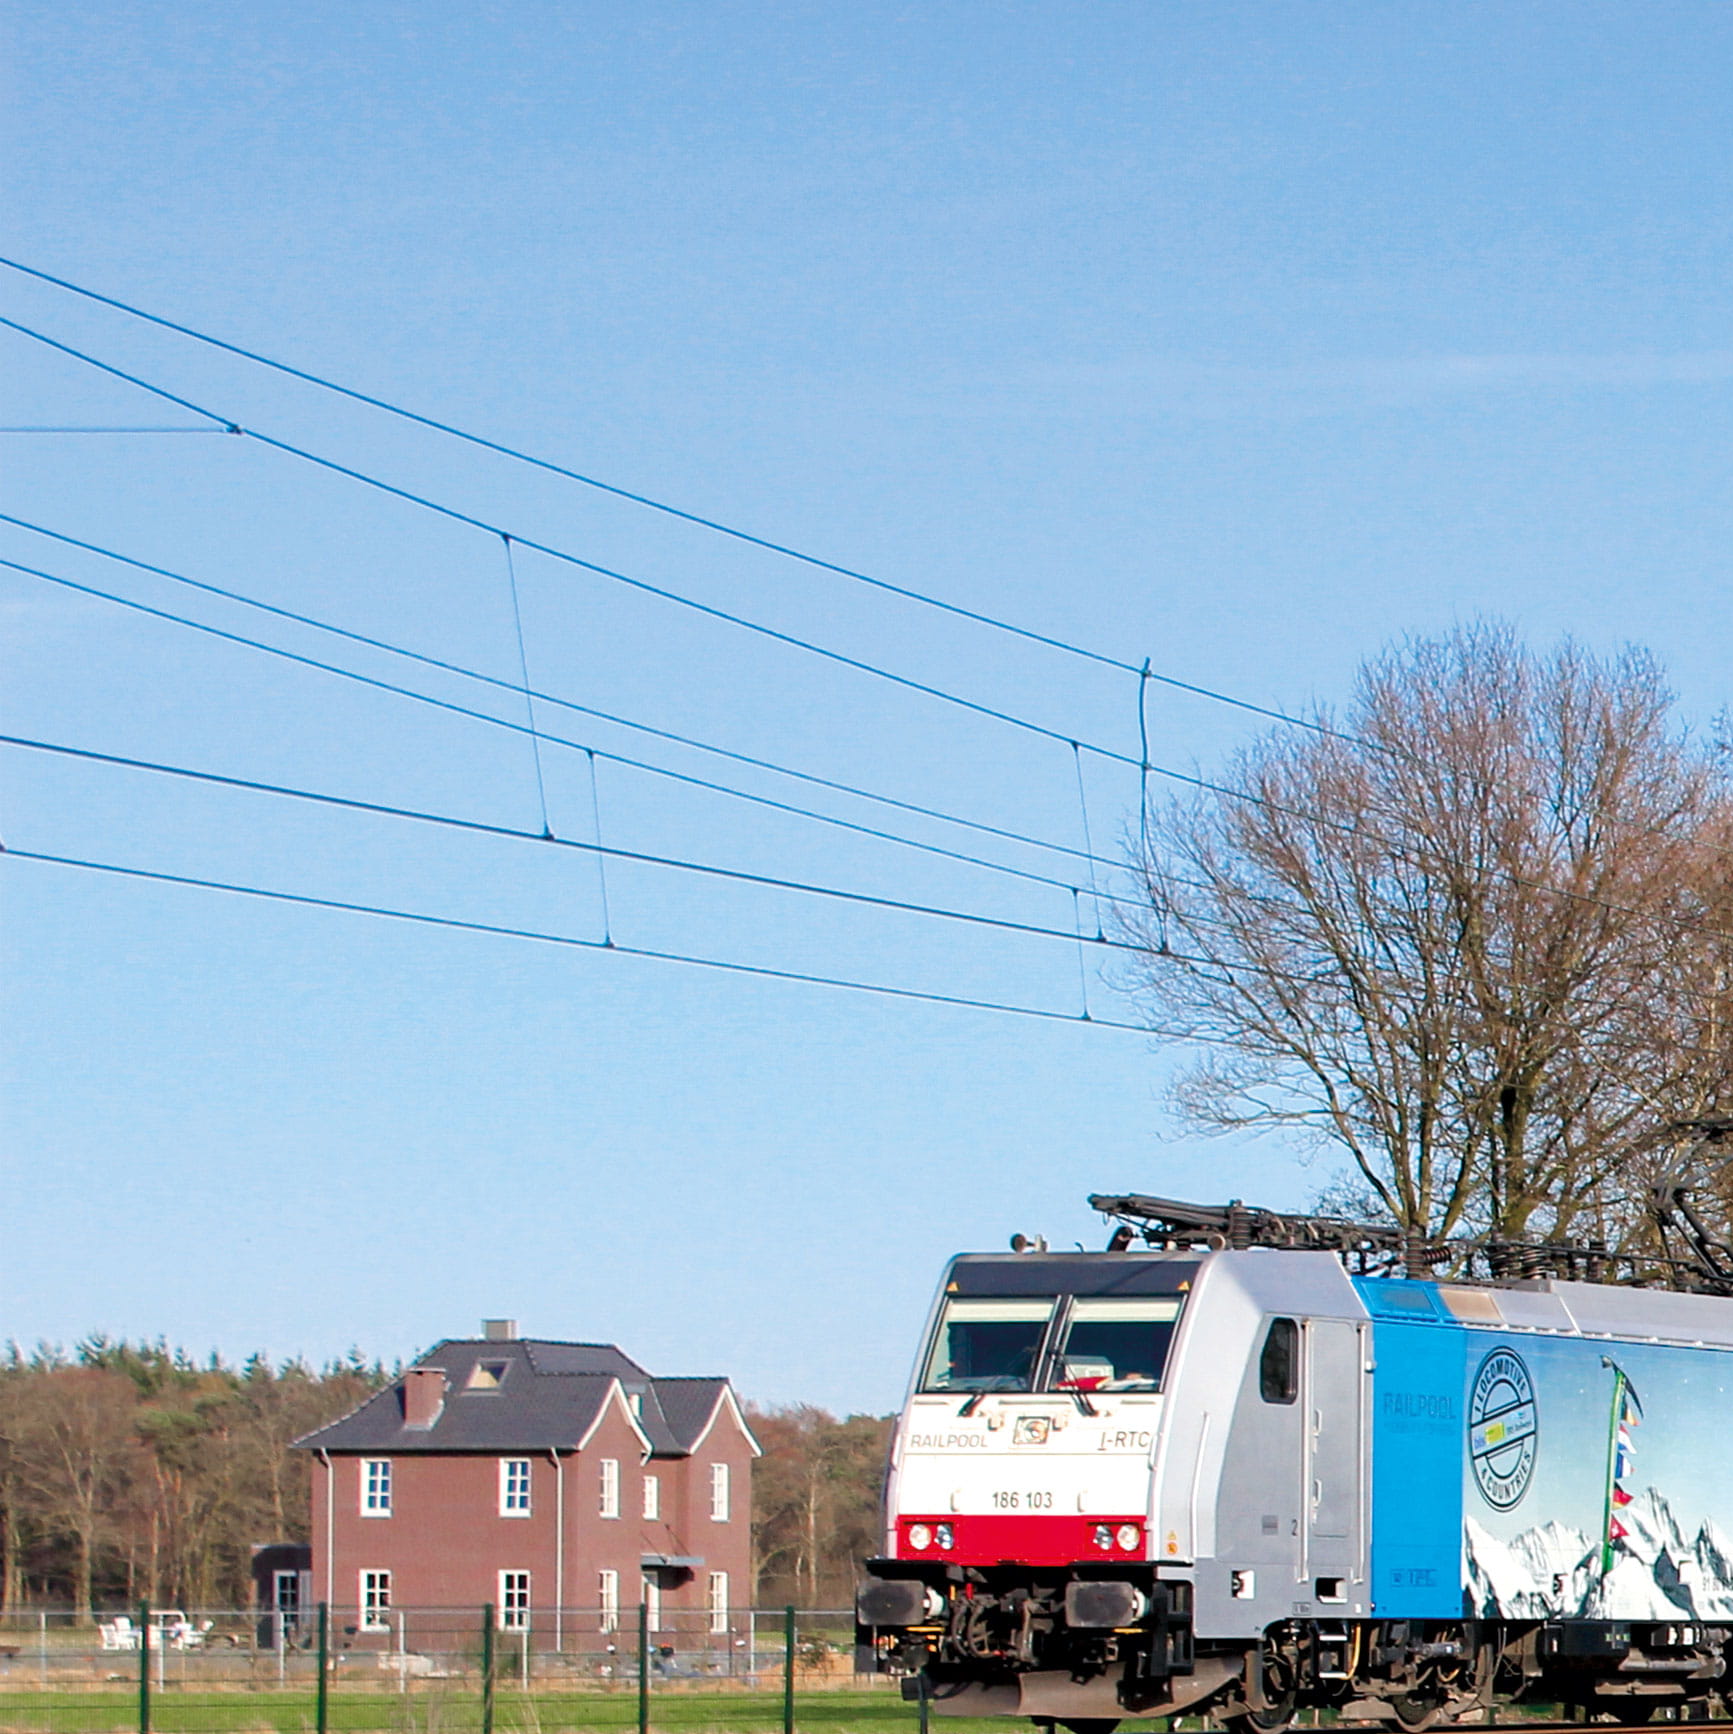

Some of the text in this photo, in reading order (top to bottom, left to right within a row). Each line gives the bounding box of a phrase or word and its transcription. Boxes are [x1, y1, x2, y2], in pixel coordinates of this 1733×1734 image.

[910, 1434, 988, 1448] RAILPOOL
[992, 1491, 1054, 1509] 186 103
